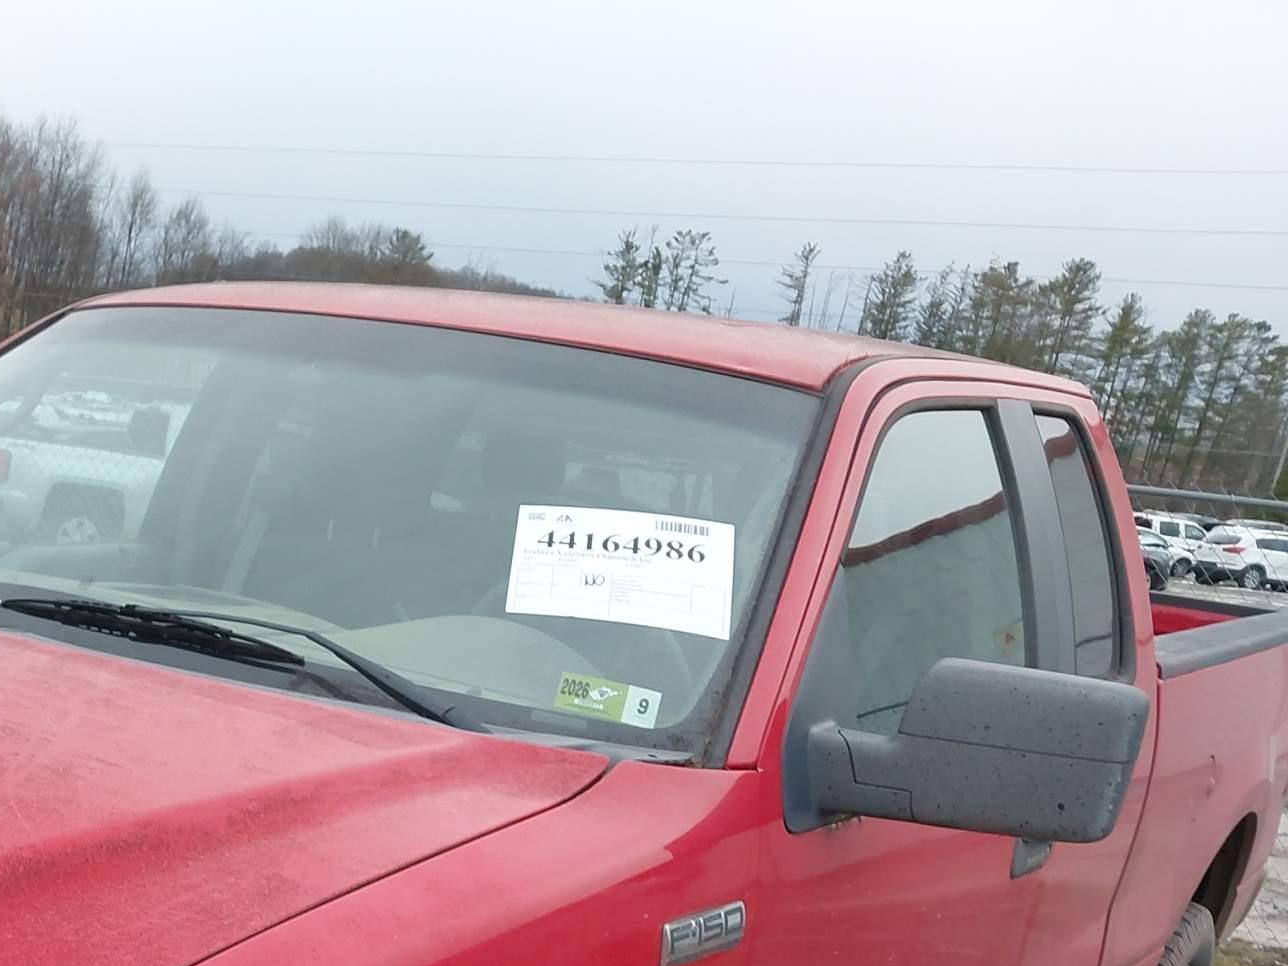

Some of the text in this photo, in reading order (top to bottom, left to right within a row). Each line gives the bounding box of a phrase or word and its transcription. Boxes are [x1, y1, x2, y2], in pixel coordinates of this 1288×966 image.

[537, 529, 706, 563] 44164986
[560, 678, 590, 699] 2026
[637, 698, 650, 715] 9
